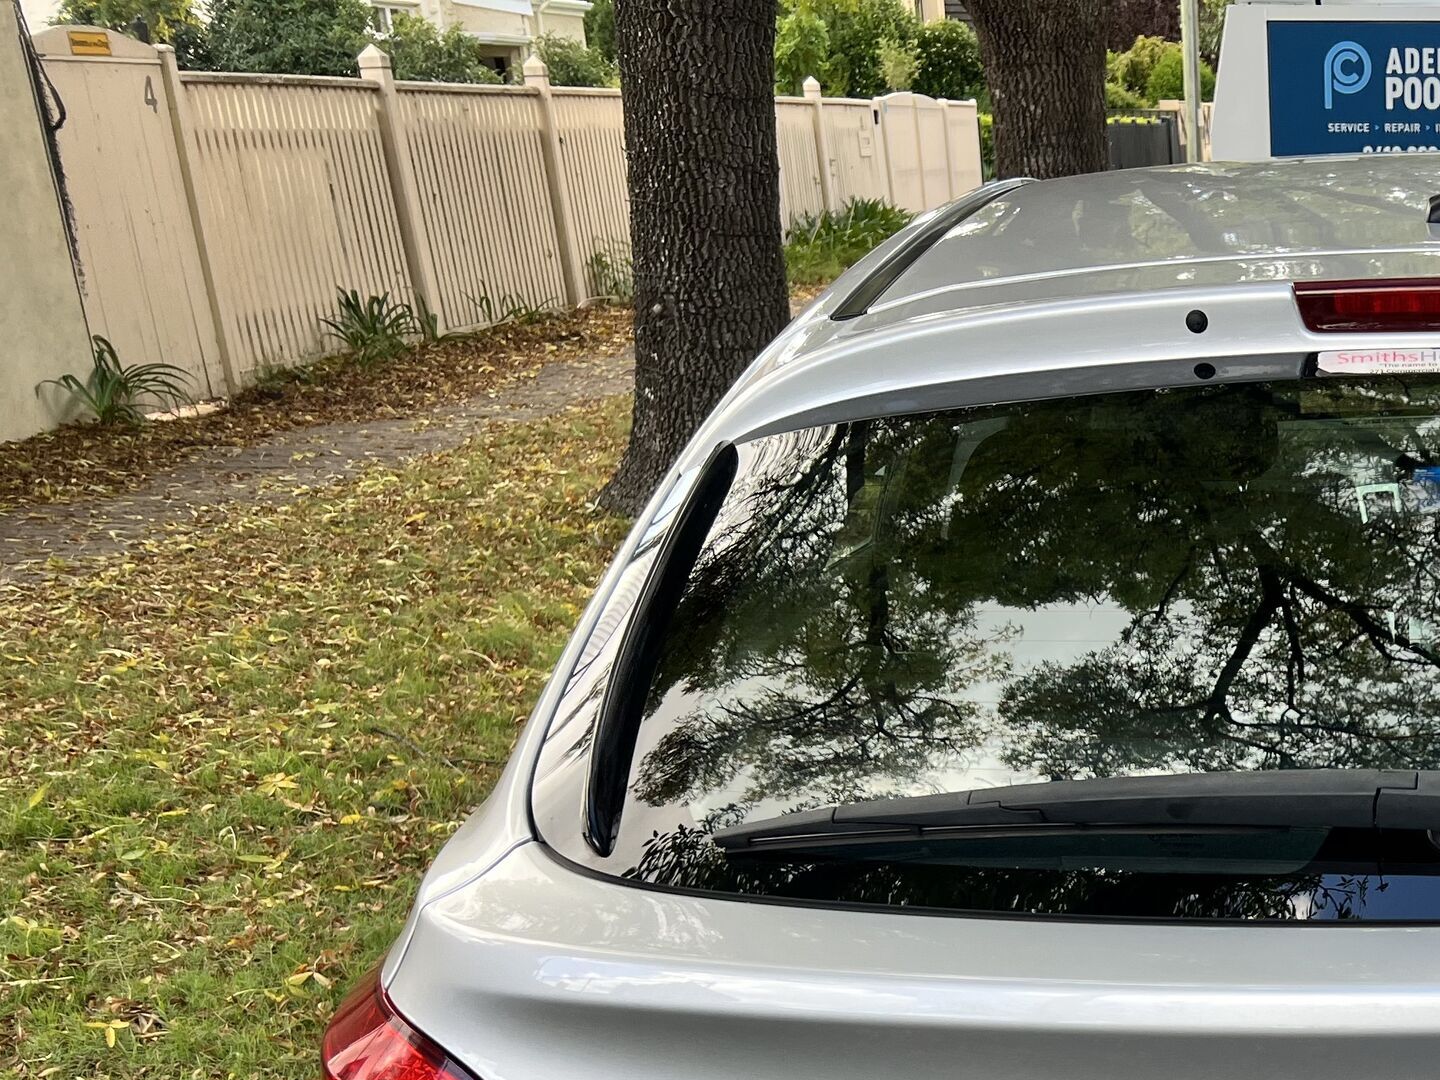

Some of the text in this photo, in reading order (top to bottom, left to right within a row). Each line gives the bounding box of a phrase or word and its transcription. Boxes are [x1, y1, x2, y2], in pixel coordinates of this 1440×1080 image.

[144, 75, 158, 114] 4
[1327, 122, 1370, 133] SERVICE
[1384, 122, 1421, 133] REPAIR
